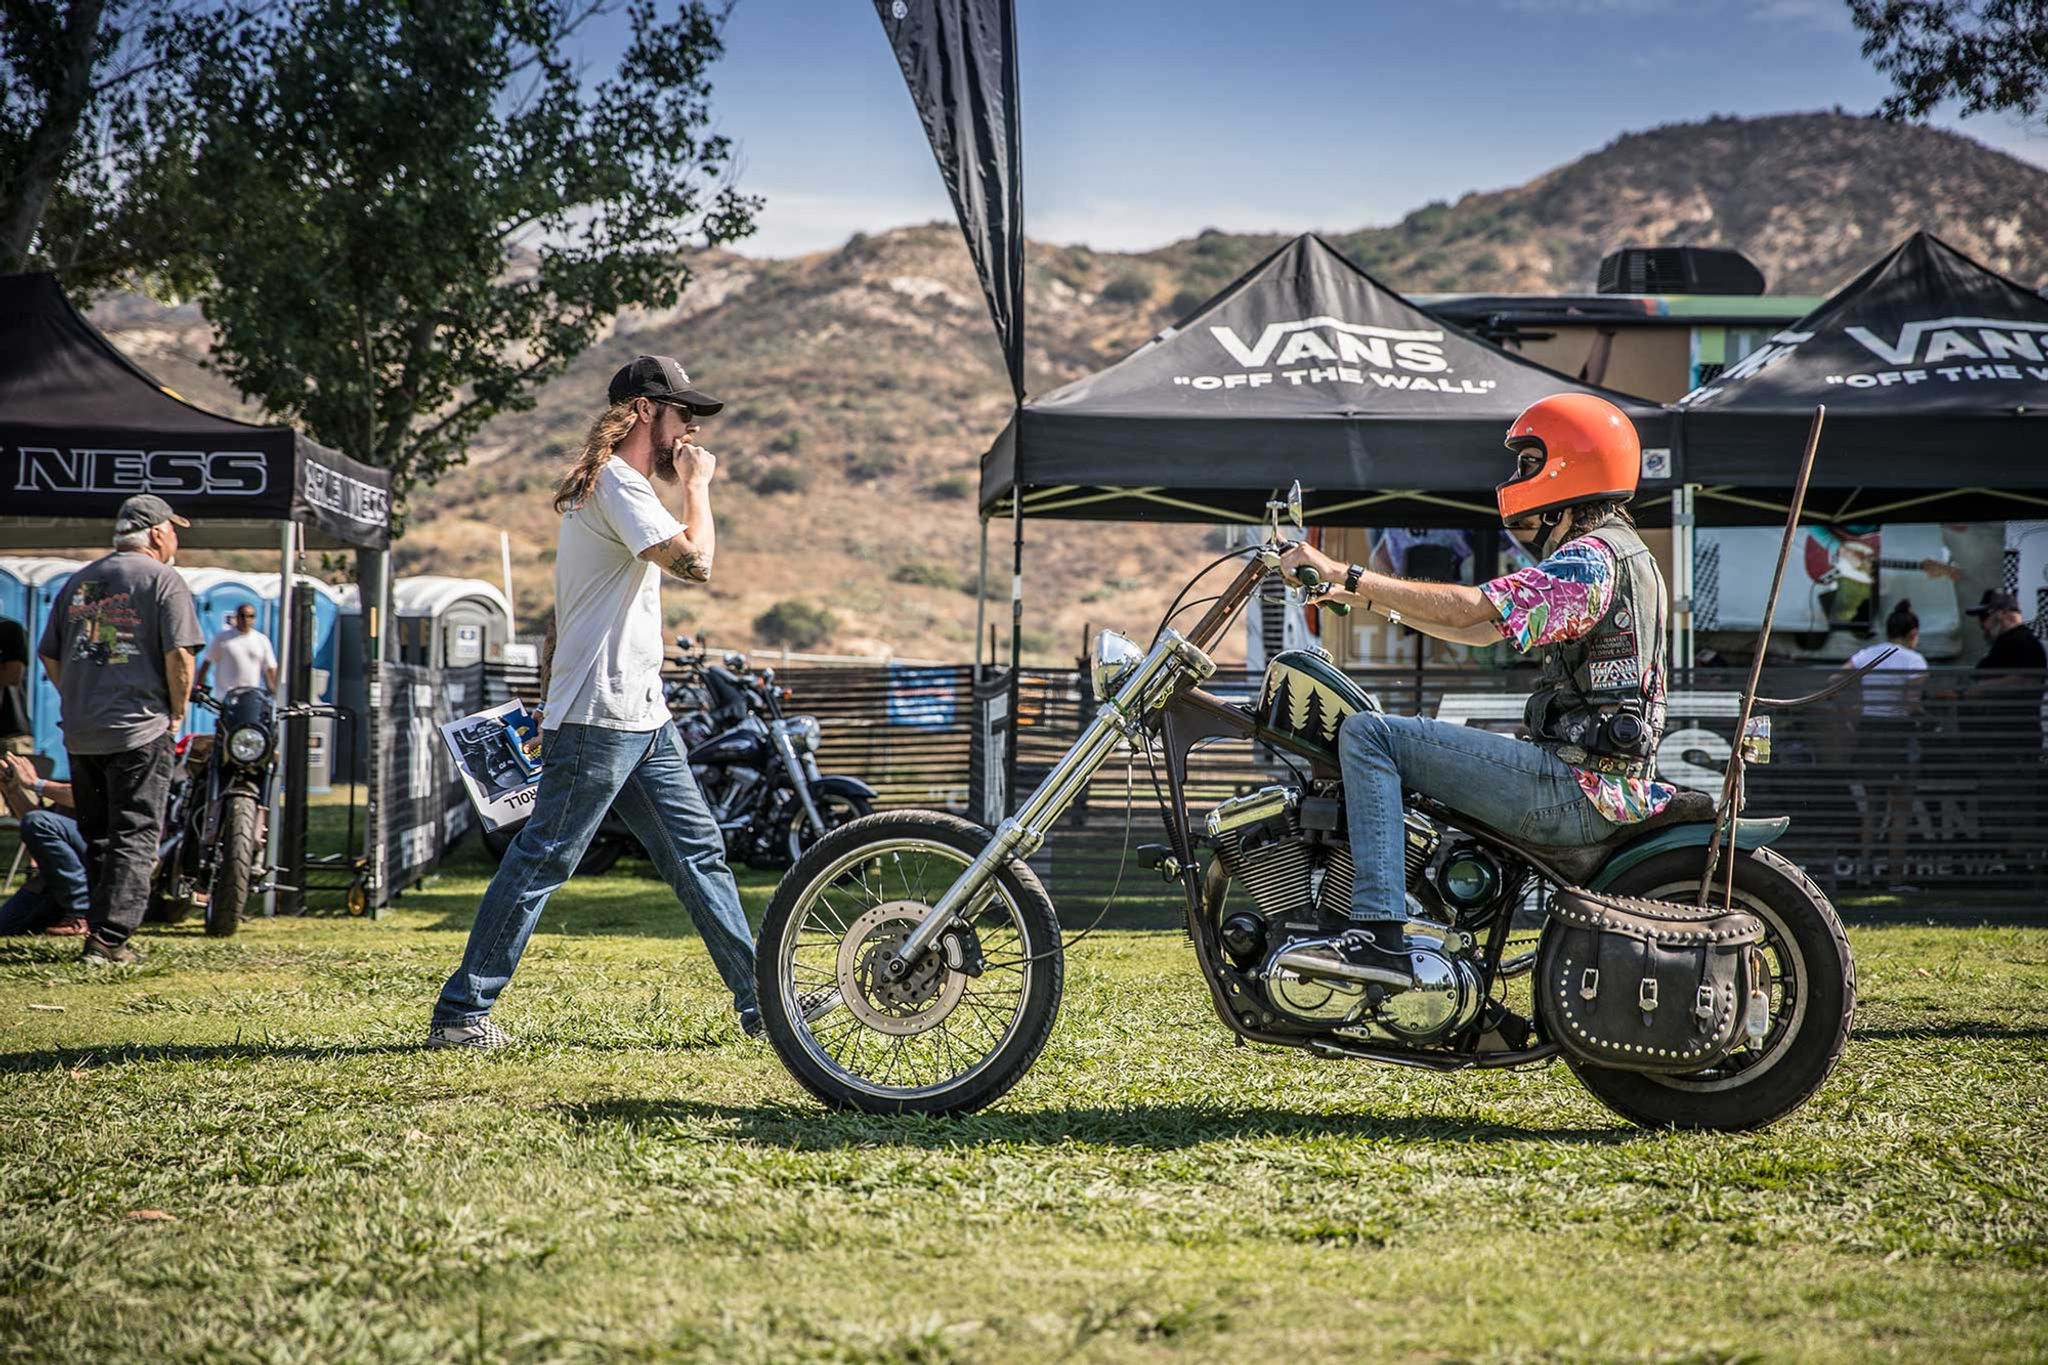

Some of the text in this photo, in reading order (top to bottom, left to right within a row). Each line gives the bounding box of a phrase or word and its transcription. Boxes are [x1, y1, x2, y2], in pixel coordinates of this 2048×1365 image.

[1209, 315, 1448, 373] VANS
[1844, 316, 2048, 366] VAN
[1282, 367, 1364, 385] THE
[1935, 364, 2023, 382] THE
[13, 446, 268, 495] NESS
